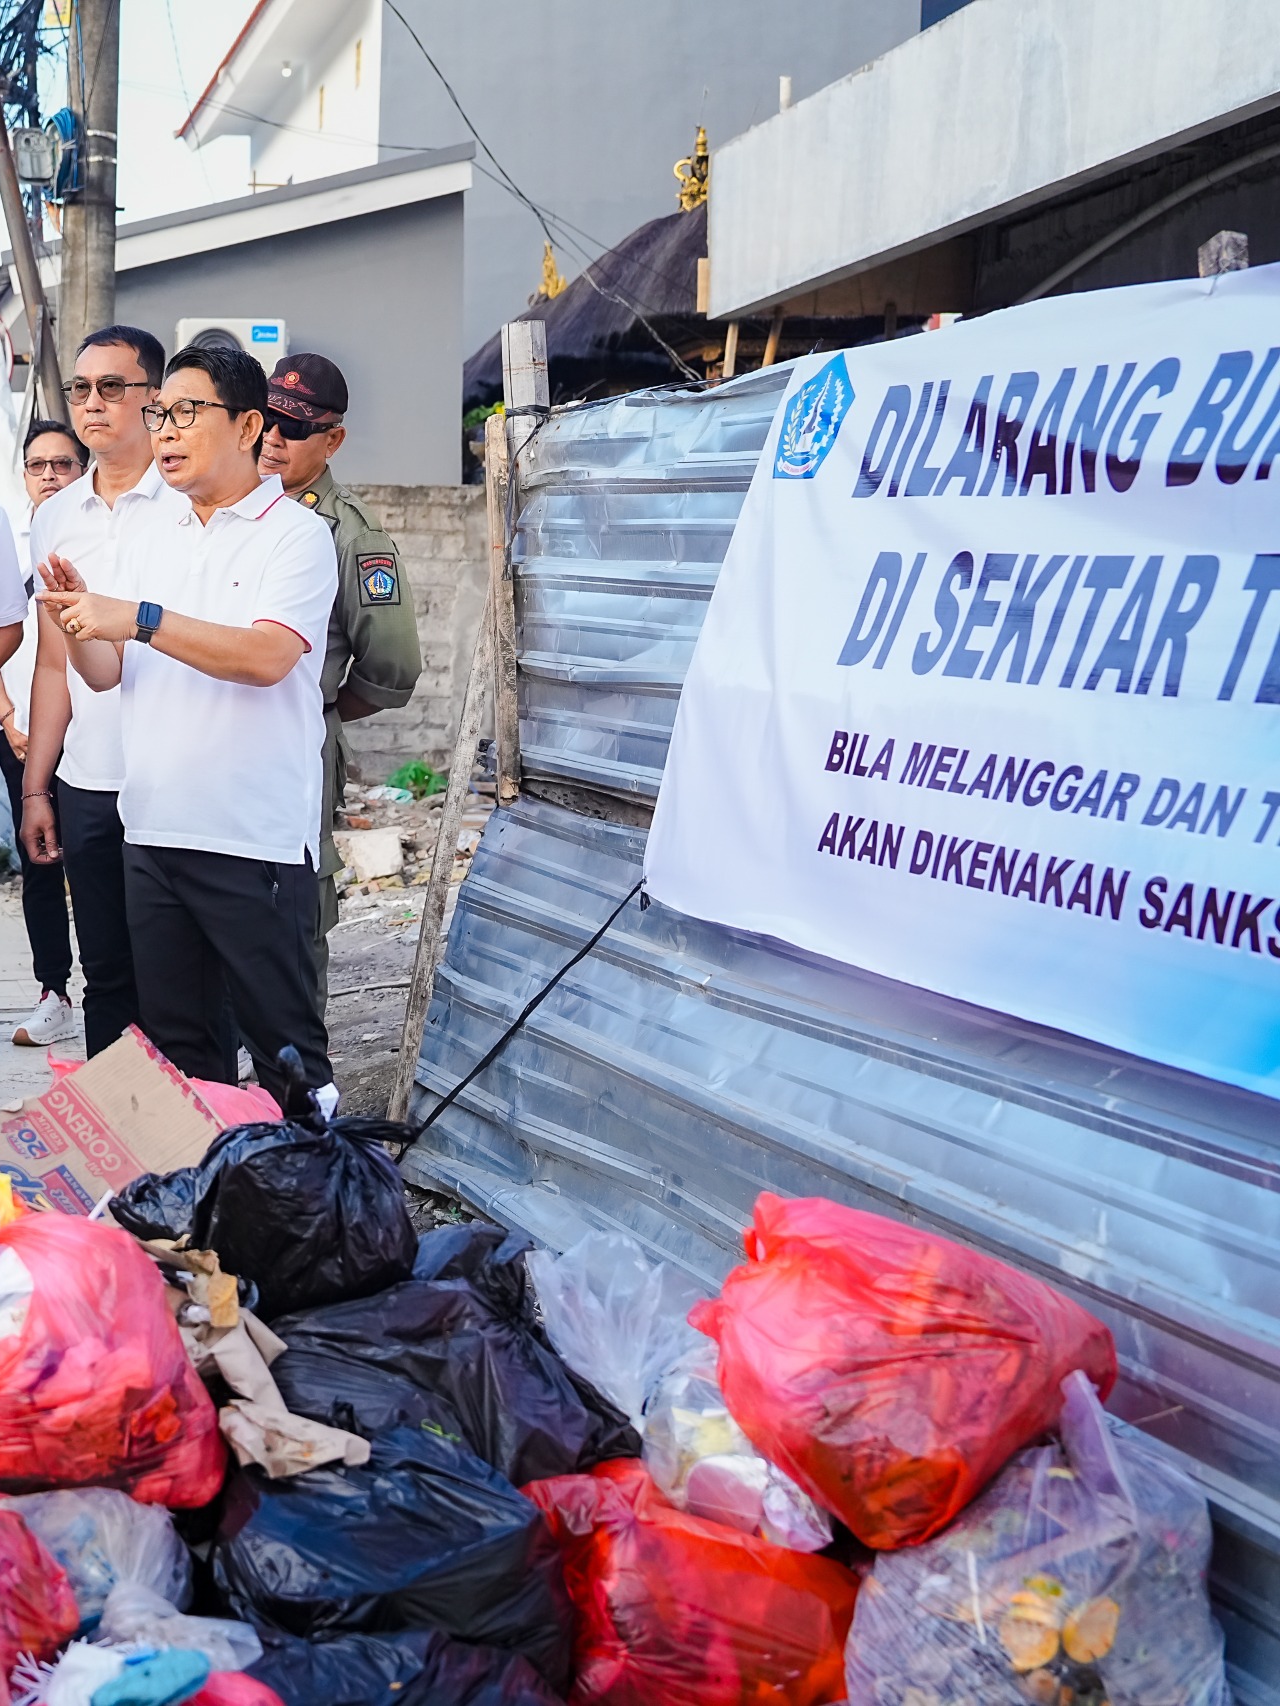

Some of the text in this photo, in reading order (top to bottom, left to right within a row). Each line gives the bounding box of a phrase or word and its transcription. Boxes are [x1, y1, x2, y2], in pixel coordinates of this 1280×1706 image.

[851, 356, 1181, 498] DILARANG
[836, 551, 928, 669] DI
[911, 550, 1220, 697] SEKITAR
[824, 730, 896, 780] BILA
[899, 741, 1141, 822] MELANGGAR
[1141, 778, 1246, 837] DAN
[817, 812, 905, 869] AKAN
[909, 830, 1131, 921] DIKENAKAN
[37, 1114, 65, 1149] KRIUK
[47, 1090, 122, 1172] GORENG
